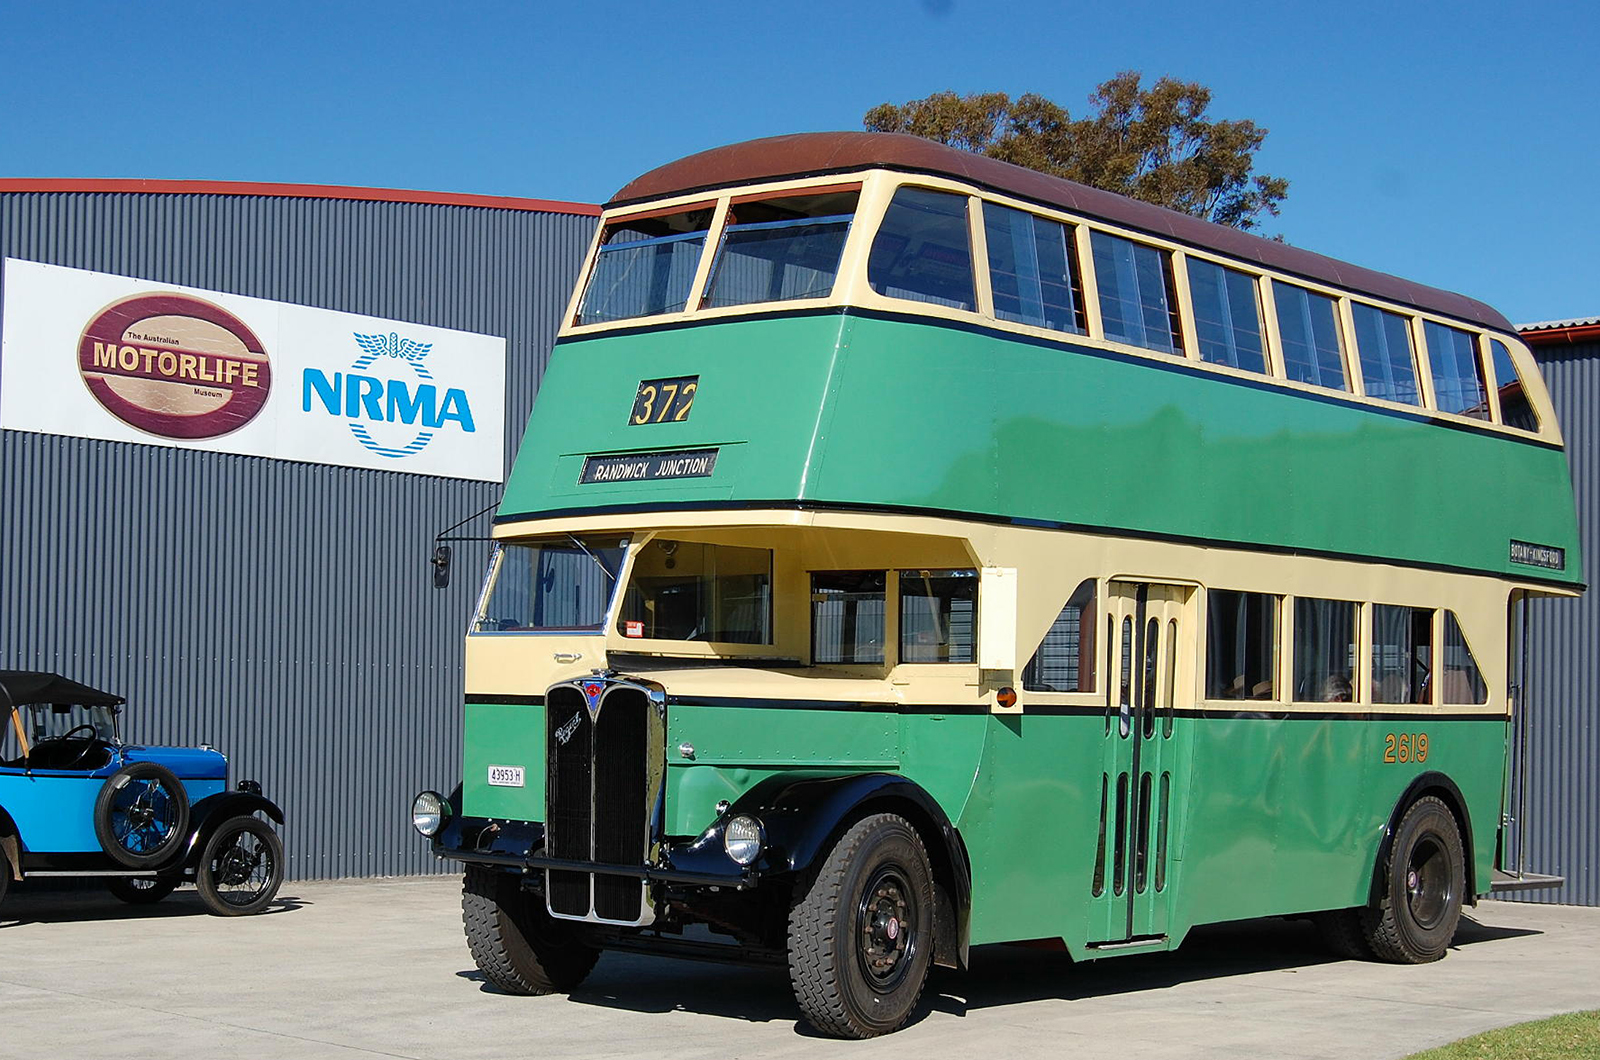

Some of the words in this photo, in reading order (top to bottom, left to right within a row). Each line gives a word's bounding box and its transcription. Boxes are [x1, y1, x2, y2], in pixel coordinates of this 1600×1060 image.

[128, 332, 141, 340] The
[143, 334, 180, 345] Australian
[93, 342, 258, 386] MOTORLIFE
[193, 388, 222, 398] Museum
[303, 368, 476, 433] NRMA
[635, 383, 697, 425] 372
[595, 462, 650, 480] RANDWICK
[655, 457, 708, 476] JUNCTION
[1384, 733, 1429, 763] 2619
